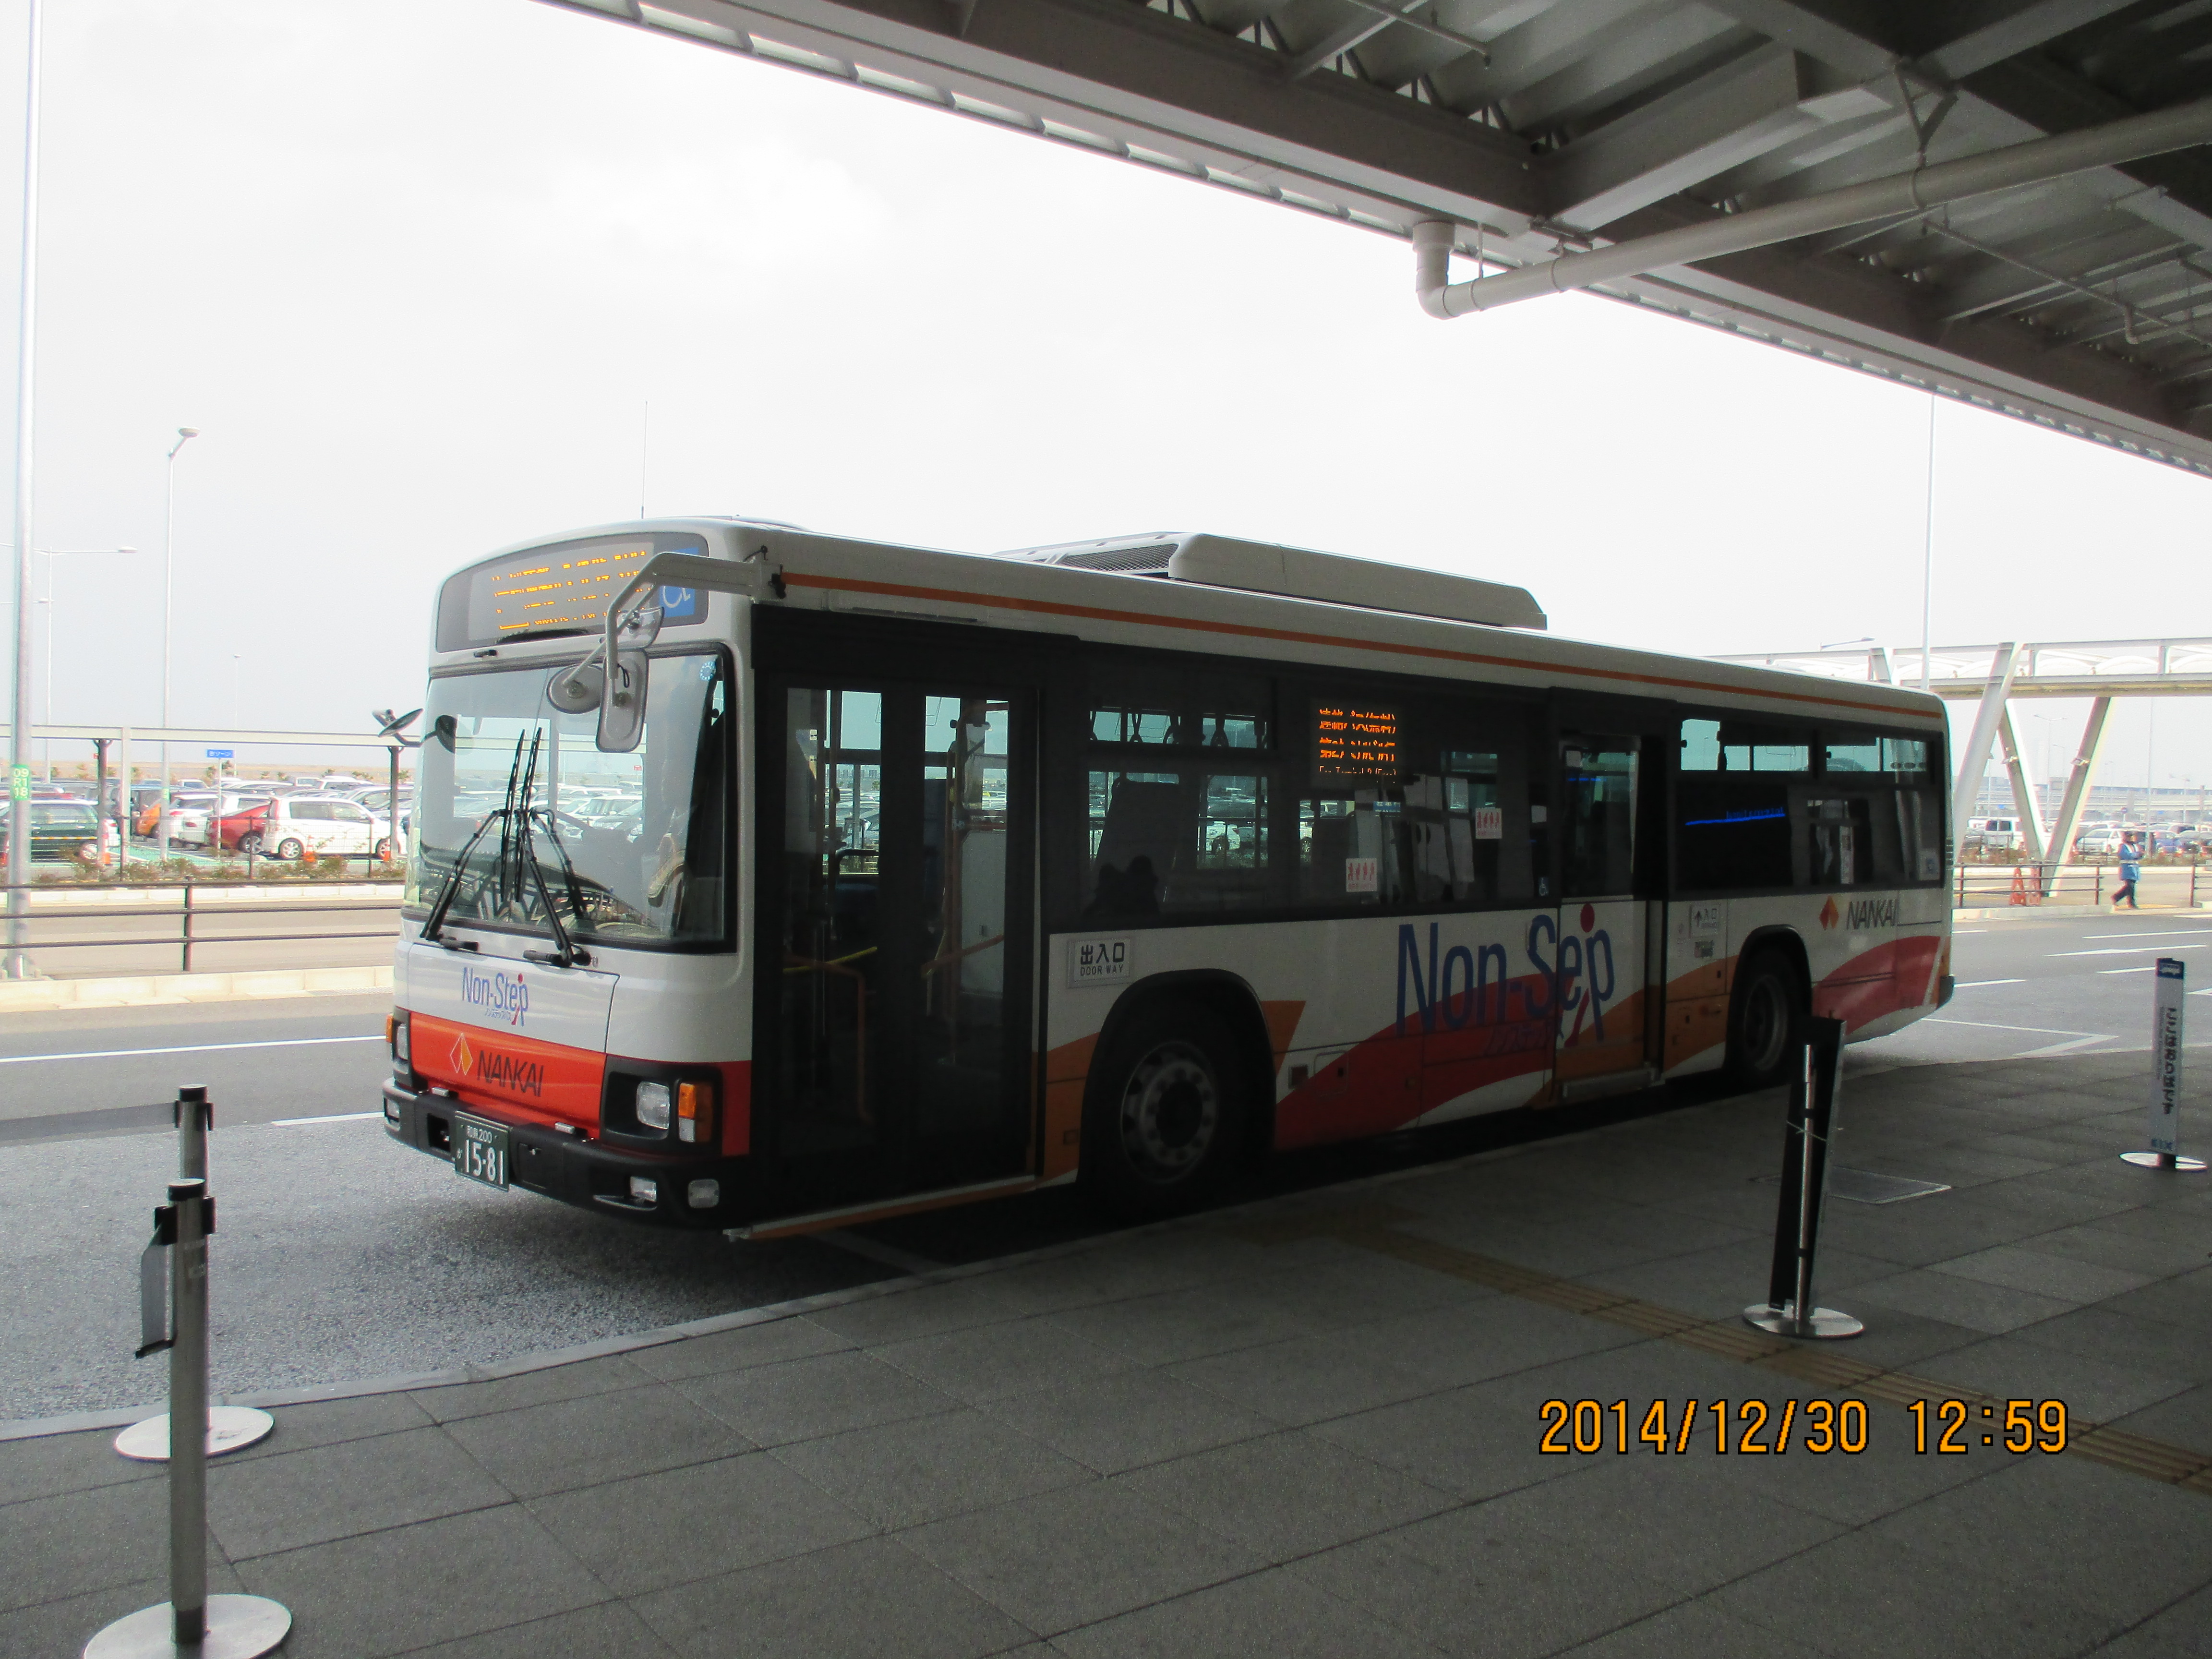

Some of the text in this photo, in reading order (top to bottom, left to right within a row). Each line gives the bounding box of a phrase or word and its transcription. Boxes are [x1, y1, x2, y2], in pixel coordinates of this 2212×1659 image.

[13, 768, 29, 777] 09
[13, 778, 28, 787] R1
[13, 787, 29, 796] 18
[1846, 899, 1899, 930] NANKAI
[1080, 942, 1125, 965] 出入口
[1080, 964, 1123, 976] DOOR WAY
[462, 967, 529, 1026] Non-Step
[477, 1050, 545, 1097] NANKAI
[465, 1139, 504, 1185] 15-81
